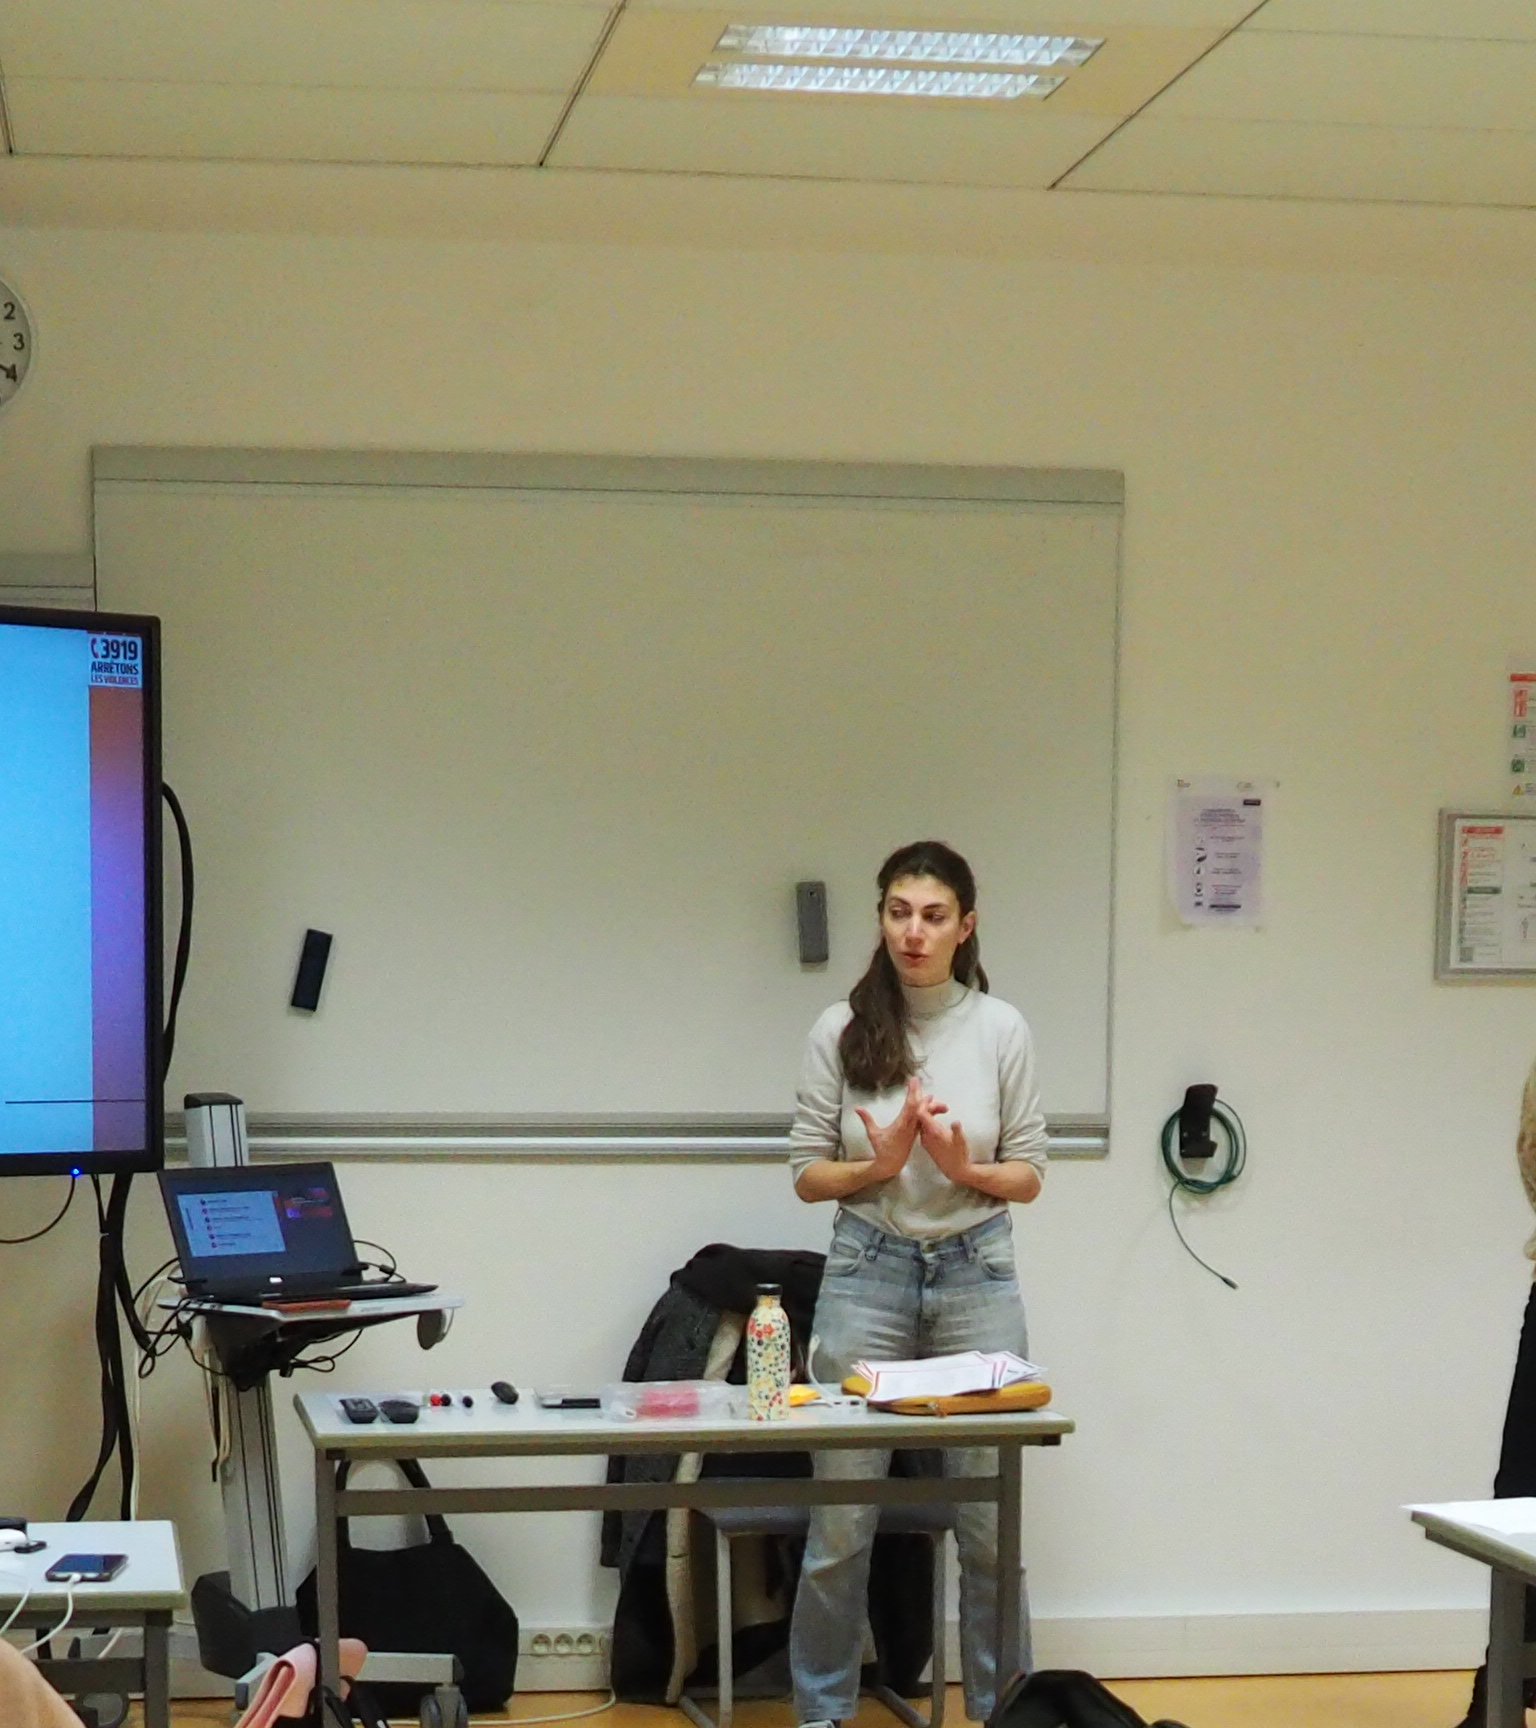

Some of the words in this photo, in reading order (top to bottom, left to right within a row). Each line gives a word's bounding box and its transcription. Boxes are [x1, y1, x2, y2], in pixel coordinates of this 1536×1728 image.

[3, 302, 16, 320] 2
[12, 333, 25, 351] 3
[100, 638, 138, 661] 3919
